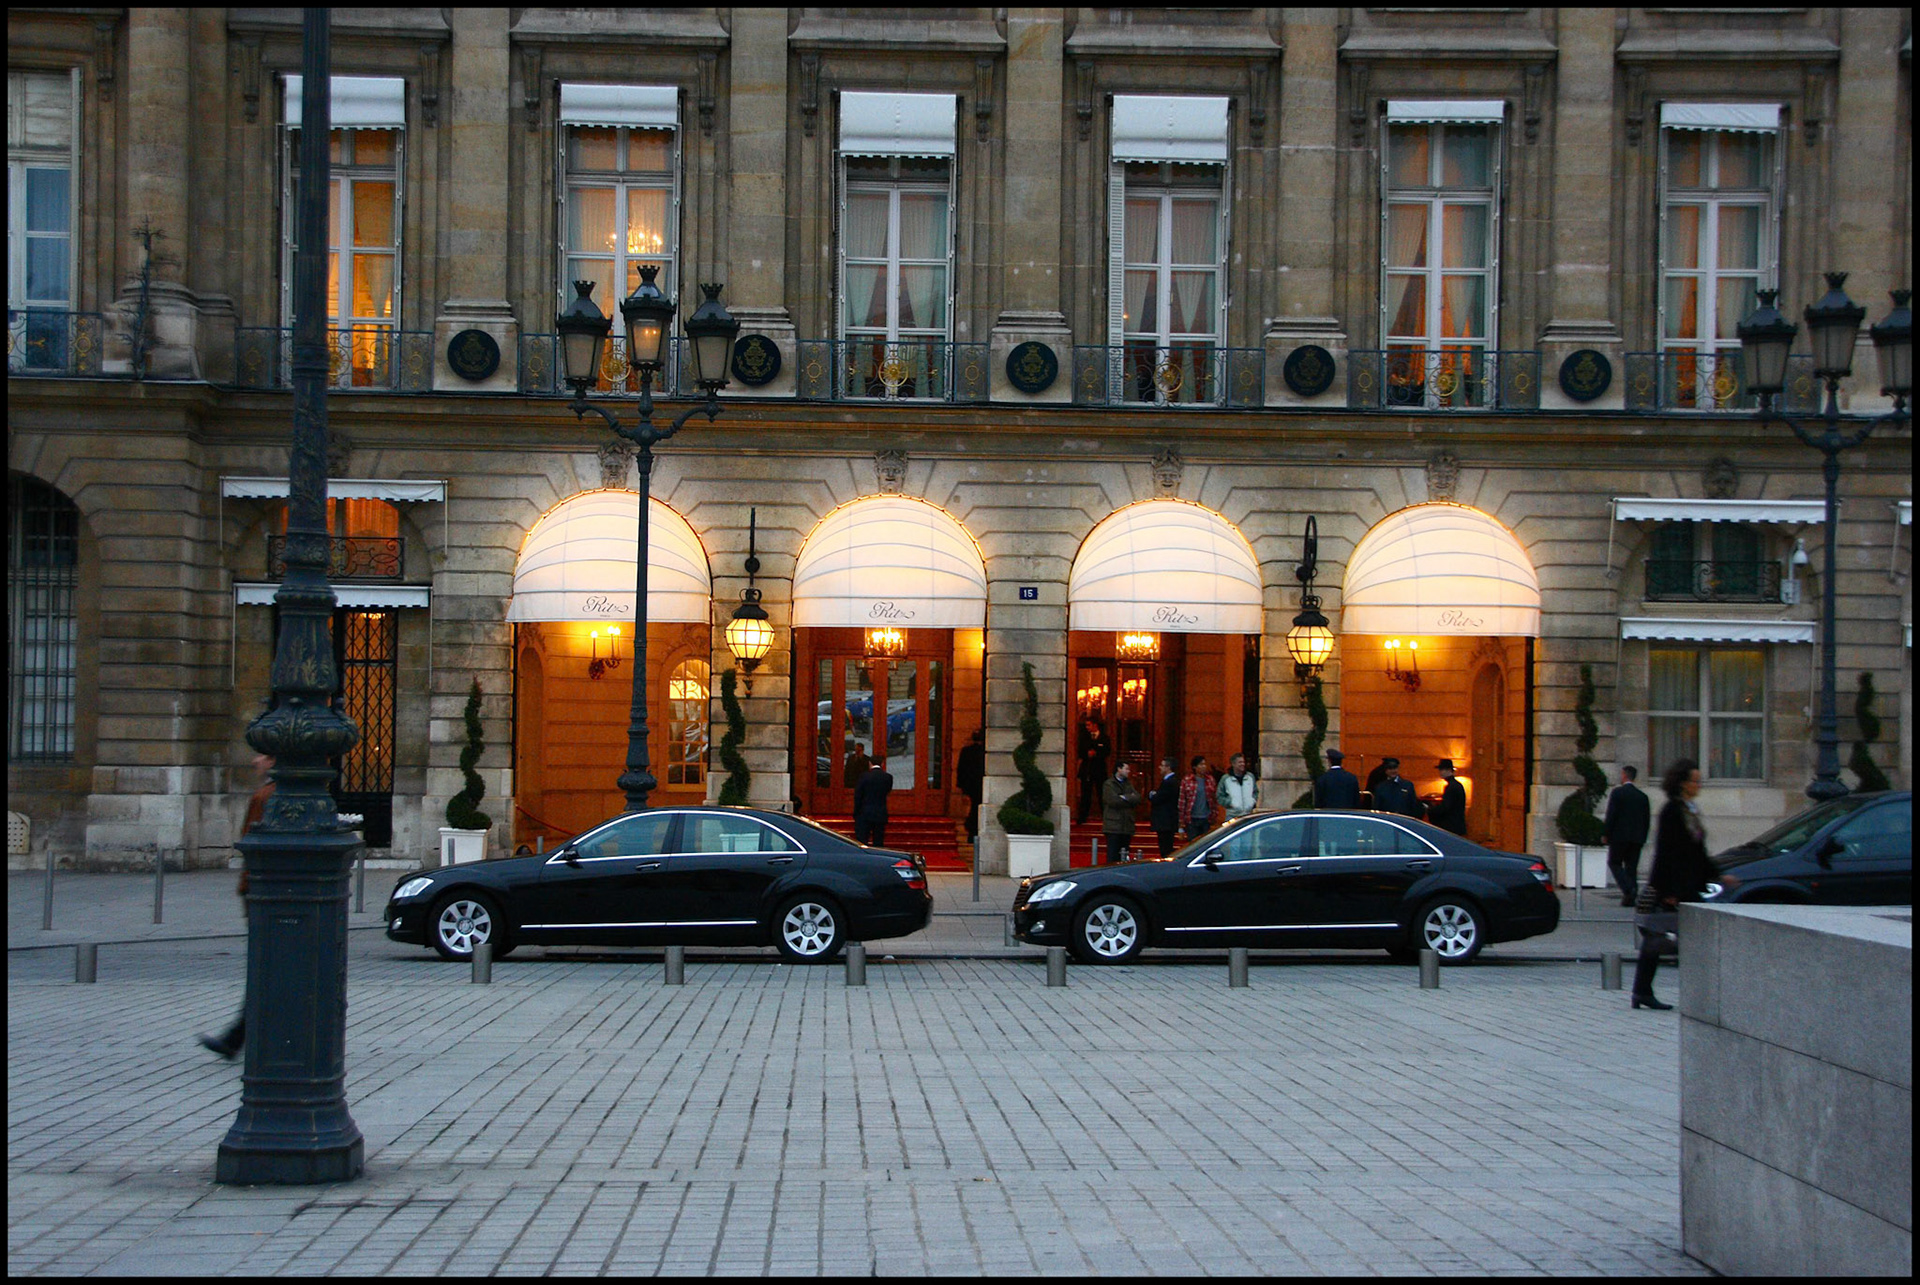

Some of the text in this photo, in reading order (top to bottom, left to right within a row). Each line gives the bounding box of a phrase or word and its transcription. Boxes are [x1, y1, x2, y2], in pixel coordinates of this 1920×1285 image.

[1023, 589, 1034, 598] 15
[582, 595, 629, 613] Ritz
[869, 601, 915, 619] Ritz
[1152, 606, 1199, 624] Ritz
[1437, 610, 1484, 627] Ritz
